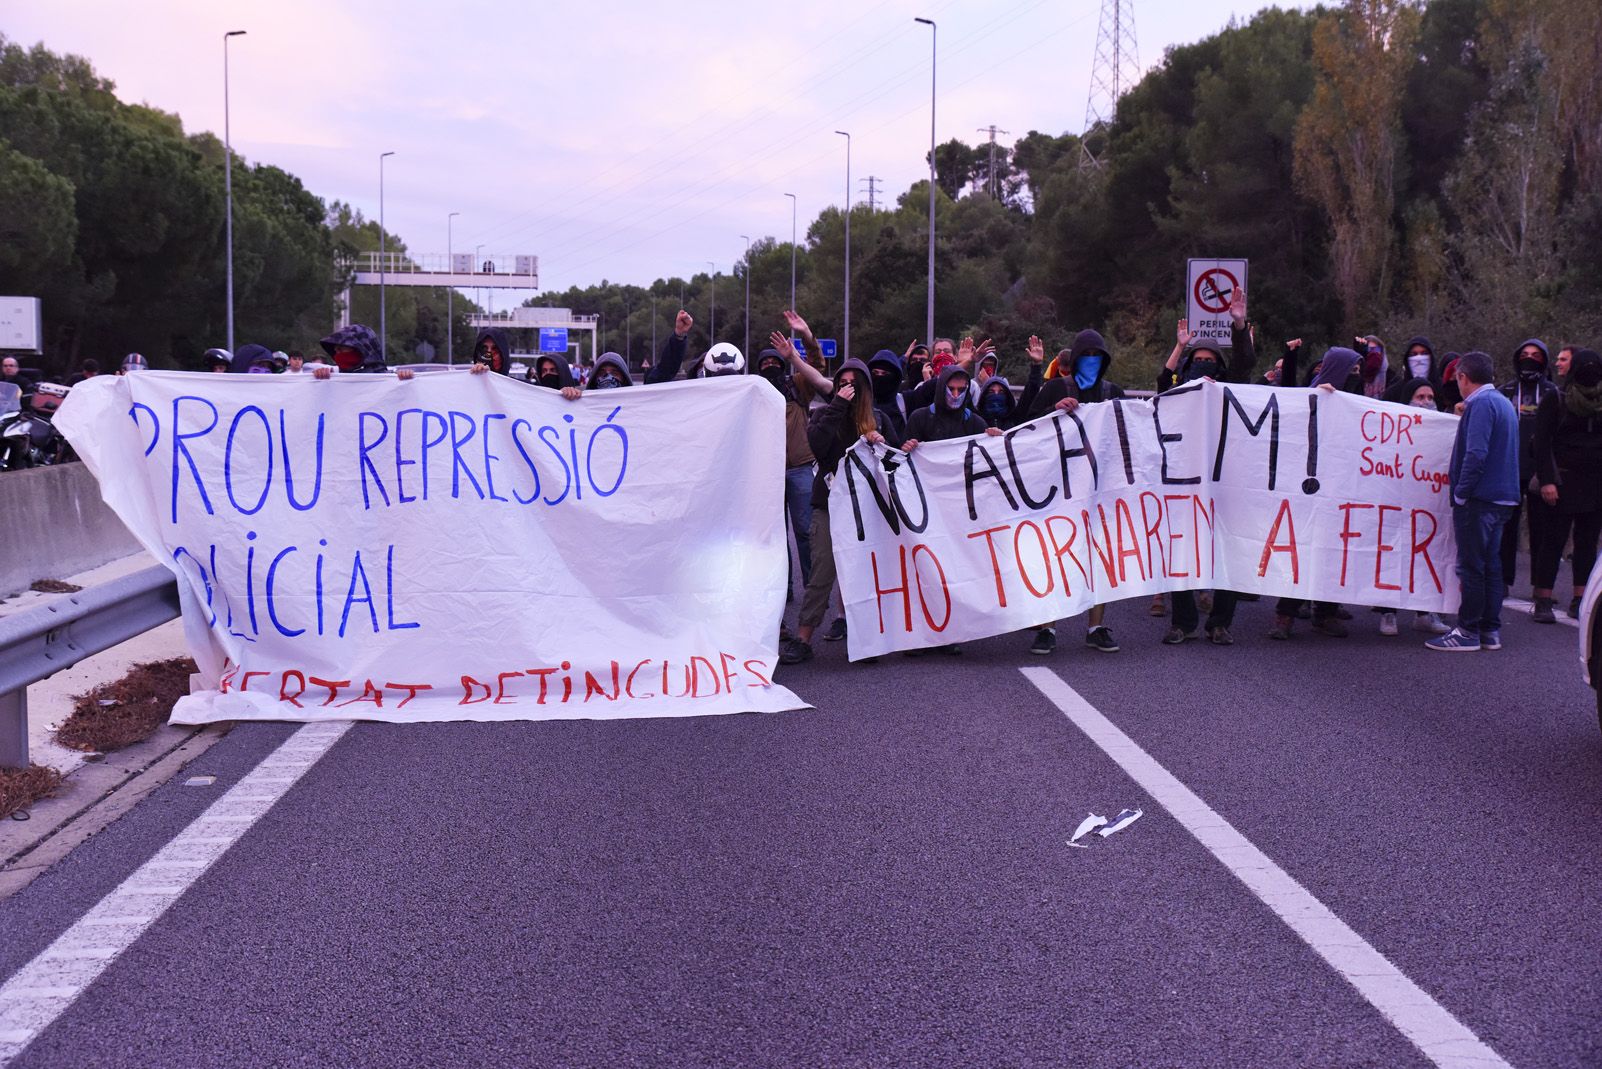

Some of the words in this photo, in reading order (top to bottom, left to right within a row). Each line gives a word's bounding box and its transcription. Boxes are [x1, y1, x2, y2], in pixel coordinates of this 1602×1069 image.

[1192, 330, 1231, 338] D'INCEN
[1200, 320, 1232, 328] PERILL
[128, 396, 324, 523] PROU
[1360, 446, 1404, 479] Sant
[1411, 455, 1450, 493] Cuga
[844, 449, 929, 541] NO
[870, 544, 951, 634] HO
[1258, 499, 1299, 585] A
[1339, 502, 1442, 594] FER
